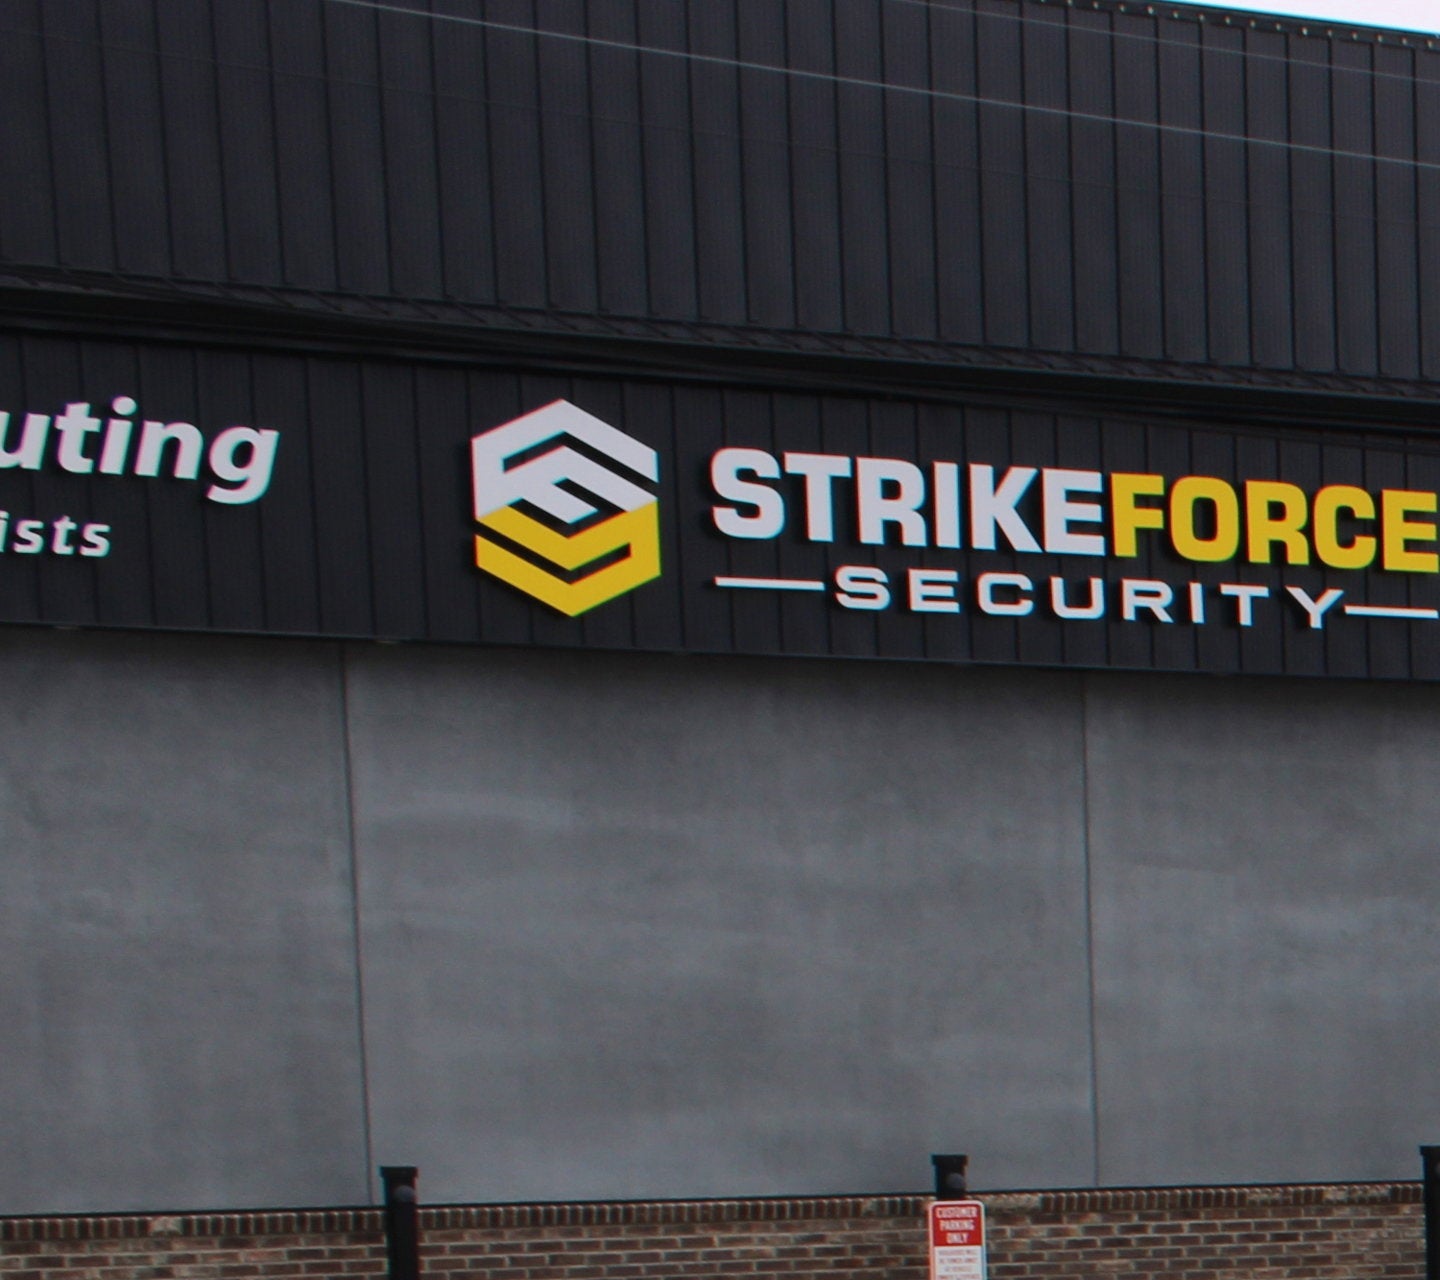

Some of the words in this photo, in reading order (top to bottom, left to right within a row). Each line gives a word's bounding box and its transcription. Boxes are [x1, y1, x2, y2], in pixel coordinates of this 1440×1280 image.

[710, 446, 1440, 573] STRIKEFORCE
[834, 564, 1344, 629] SECURITY
[935, 1206, 978, 1219] CUSTOMER
[939, 1219, 976, 1231] PARKING
[946, 1232, 969, 1244] ONLY
